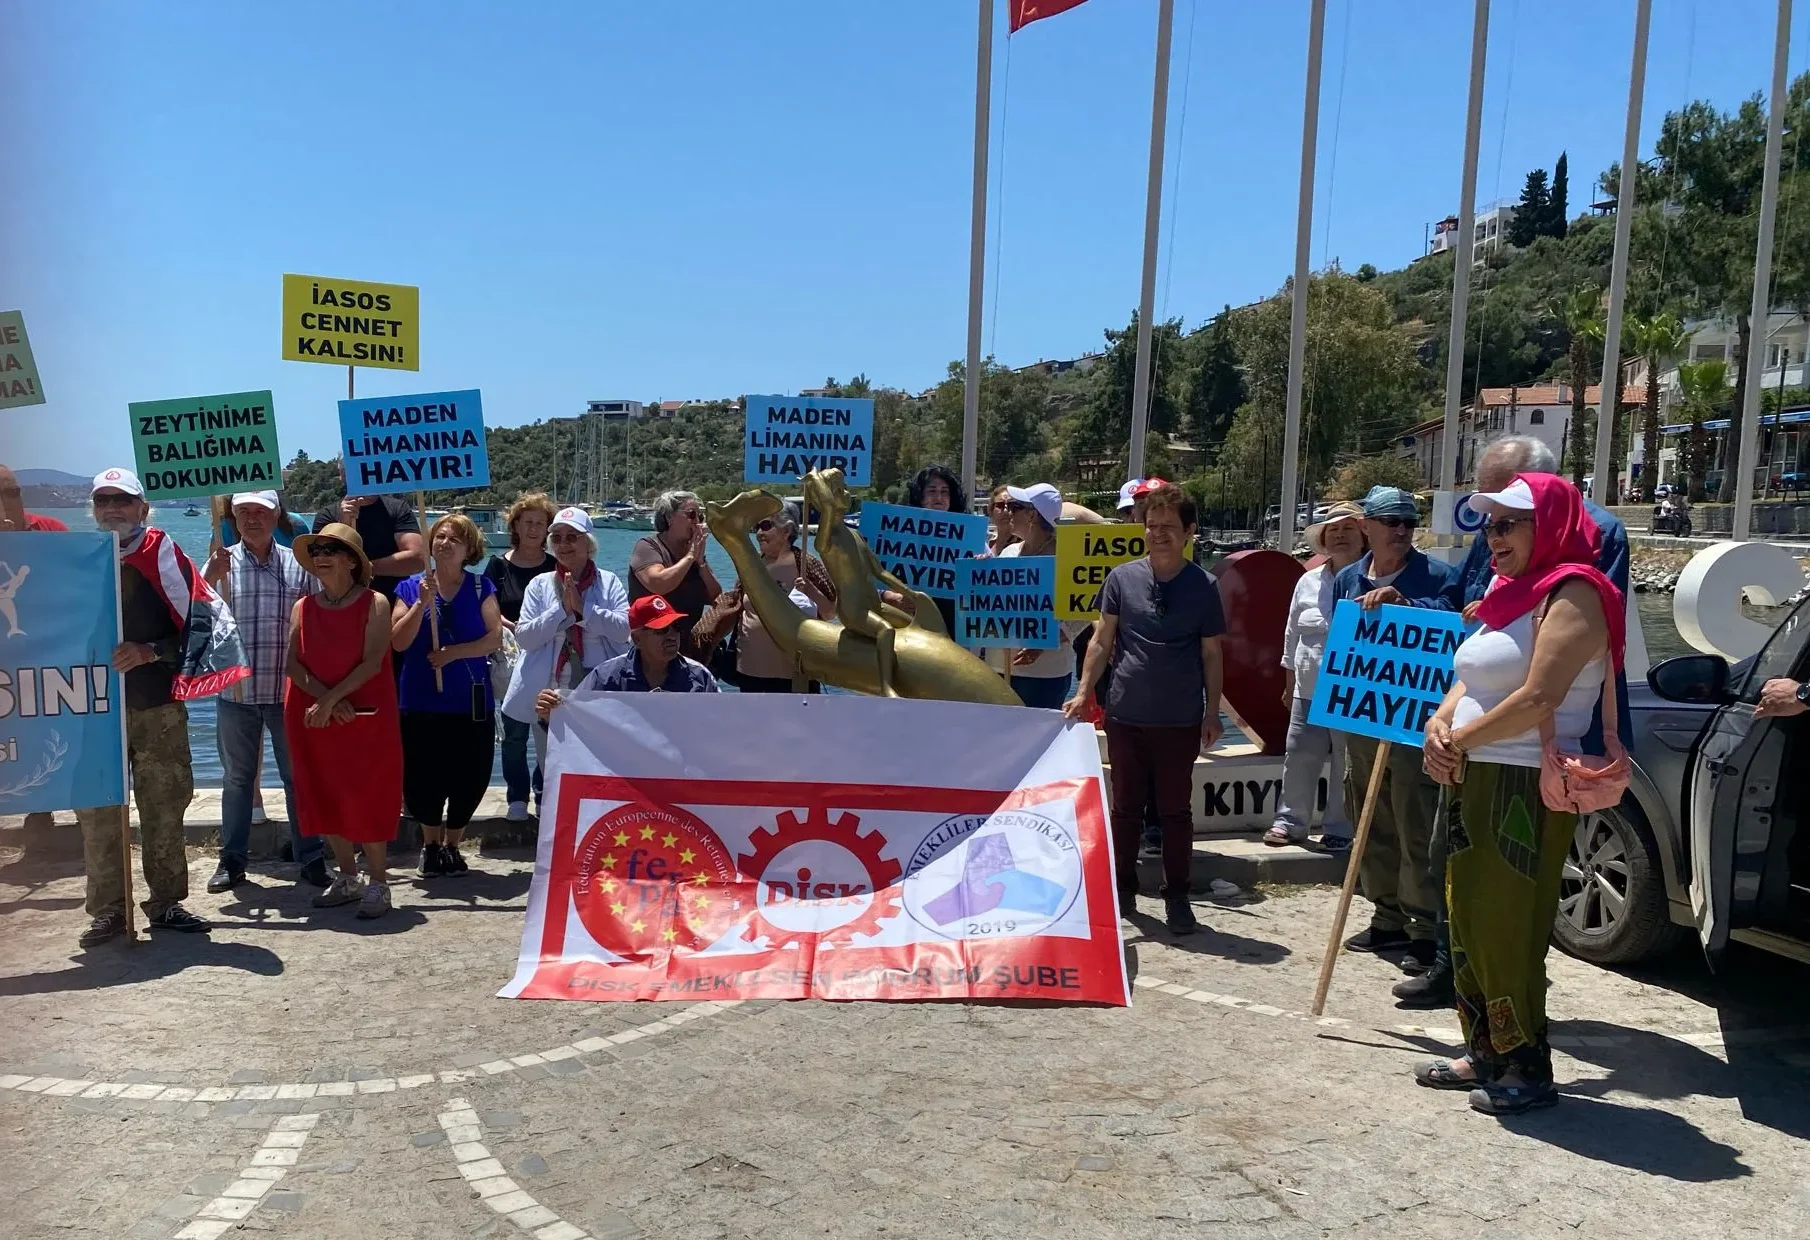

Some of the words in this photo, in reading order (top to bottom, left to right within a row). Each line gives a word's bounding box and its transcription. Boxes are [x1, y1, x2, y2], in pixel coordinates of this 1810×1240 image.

[312, 283, 391, 312] İASOS
[301, 312, 402, 337] CENNET
[298, 337, 403, 363] KALSIN!
[139, 404, 266, 435] ZEYTİNİME
[362, 403, 457, 428] MADEN
[768, 406, 851, 426] MADEN
[148, 434, 265, 463] BALIĞIMA
[348, 429, 479, 457] LİMANINA
[751, 427, 866, 451] LİMANINA
[145, 462, 274, 490] DOKUNMA!
[360, 454, 473, 485] HAYIR!
[880, 514, 965, 541] MADEN
[1084, 532, 1147, 556] İASO
[971, 568, 1040, 586] MADEN
[959, 590, 1054, 612] LİMANINA
[965, 616, 1047, 640] HAYIR!
[1354, 617, 1466, 655] MADEN
[1326, 646, 1455, 695] LİMANIN
[993, 814, 1074, 852] SENDİKASI
[968, 919, 1017, 936] 2019
[993, 965, 1081, 990] ŞUBE
